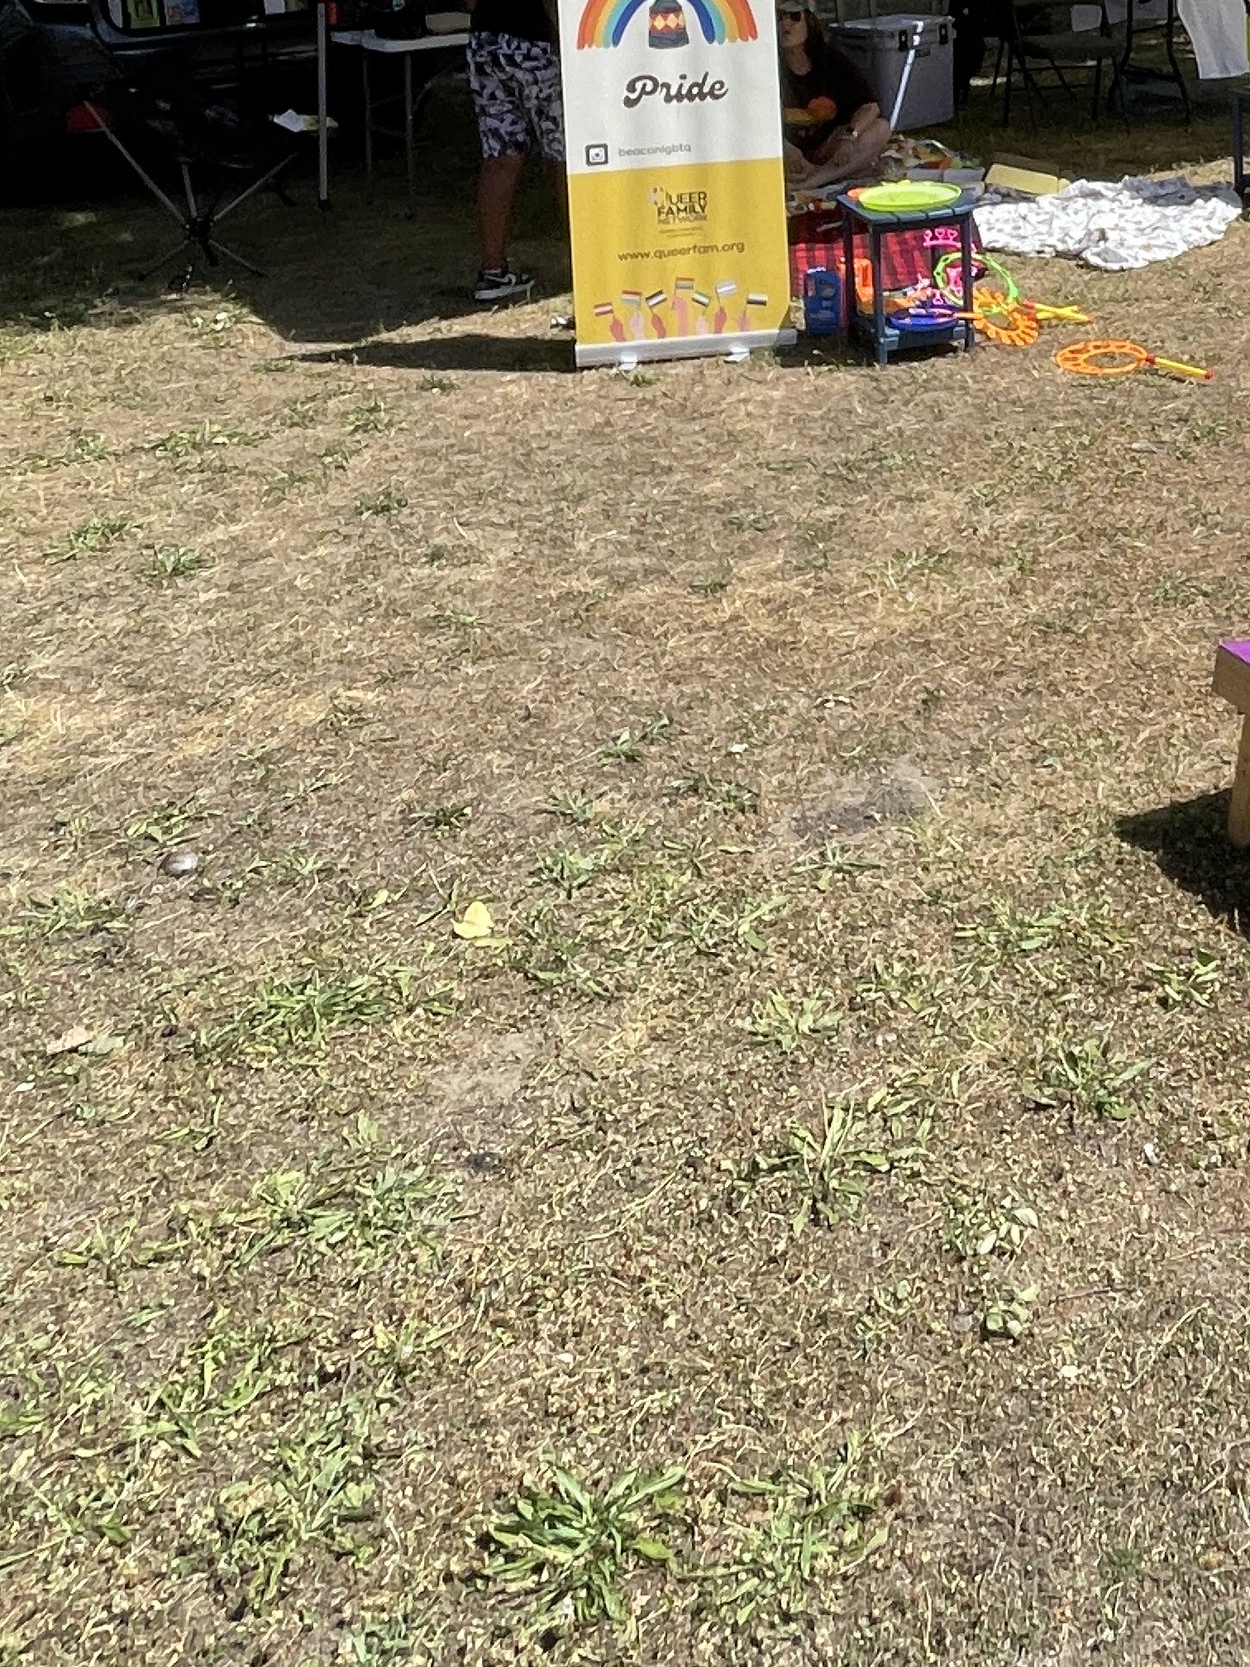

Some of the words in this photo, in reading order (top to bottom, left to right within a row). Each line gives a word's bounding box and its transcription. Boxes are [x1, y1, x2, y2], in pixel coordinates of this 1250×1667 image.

[623, 71, 729, 109] Pride
[657, 204, 708, 218] FAMILY
[617, 241, 746, 262] www.queerfam.org
